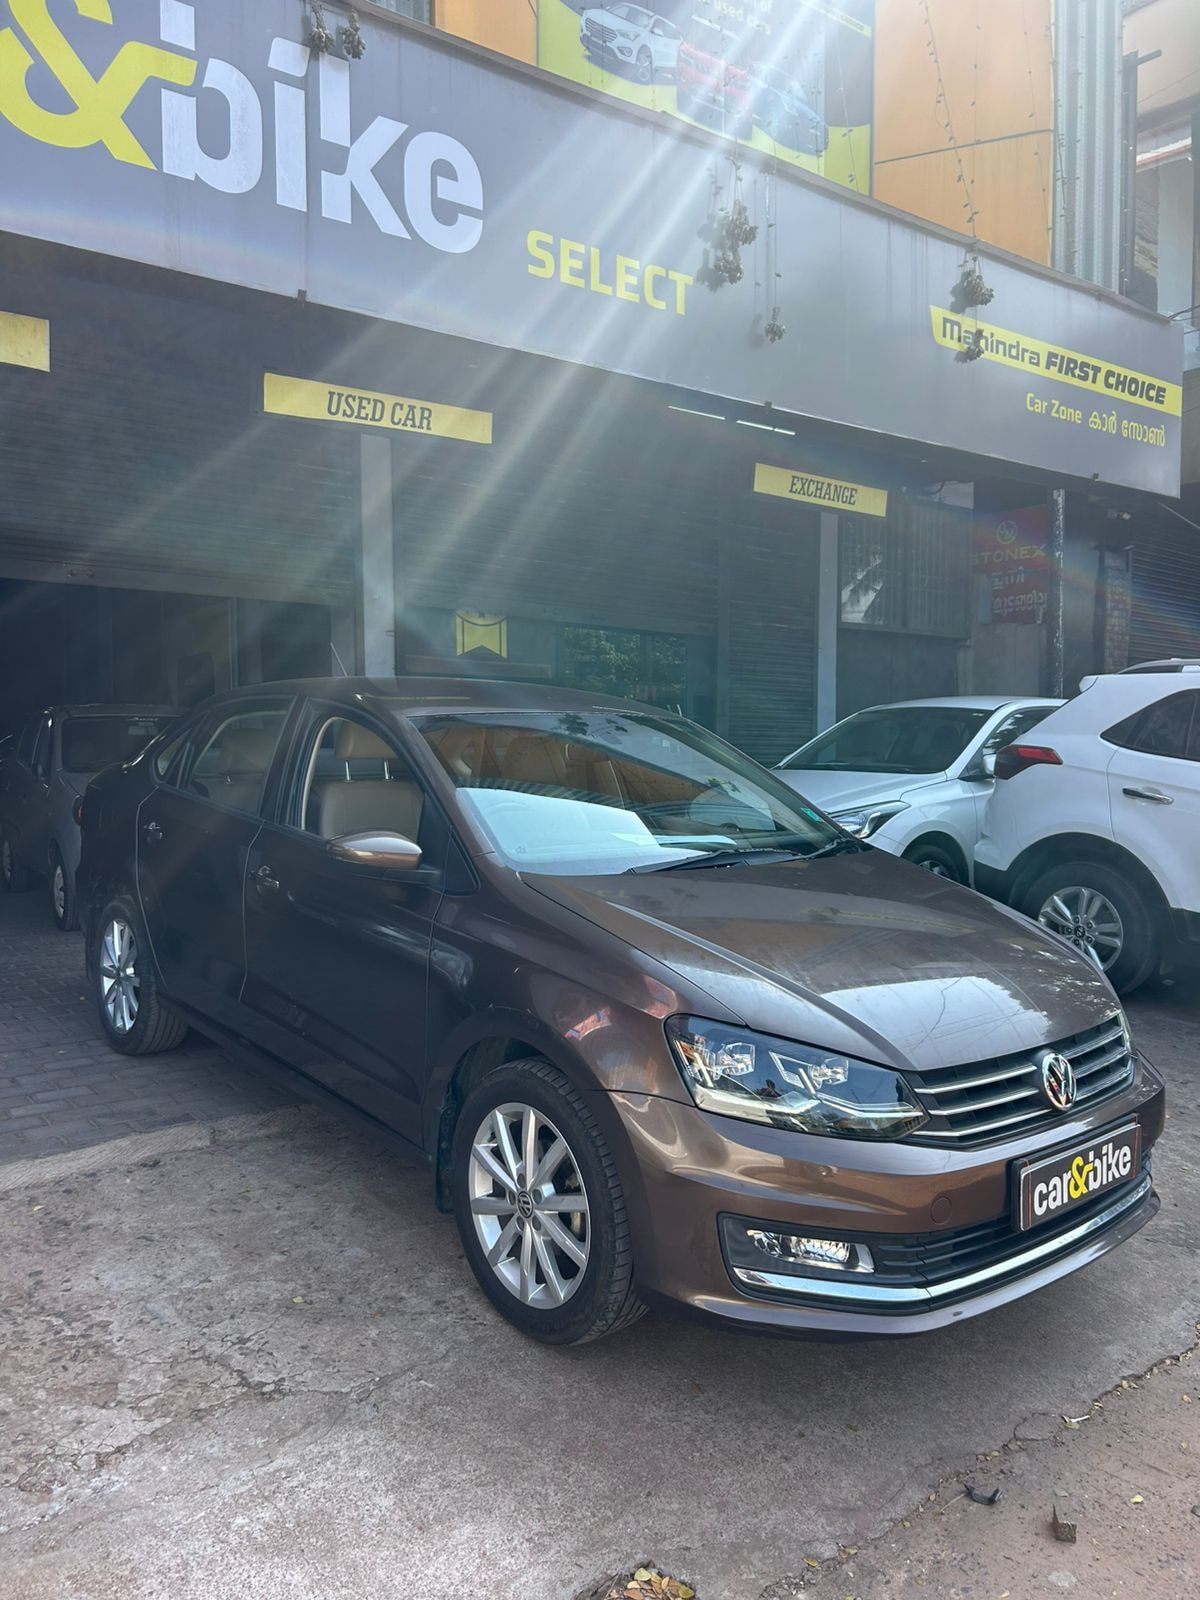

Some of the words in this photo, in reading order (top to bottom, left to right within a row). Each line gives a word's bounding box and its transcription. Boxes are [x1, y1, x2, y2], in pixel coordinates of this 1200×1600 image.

[527, 230, 694, 315] SELECT
[1045, 351, 1101, 385] FIRST
[1104, 369, 1167, 405] CHOICE
[327, 391, 385, 422] USED
[390, 402, 433, 430] CAR
[1026, 392, 1048, 414] Car
[1051, 400, 1082, 423] Zone
[789, 475, 858, 505] EXCHANGE
[1033, 1142, 1132, 1216] car&bike
